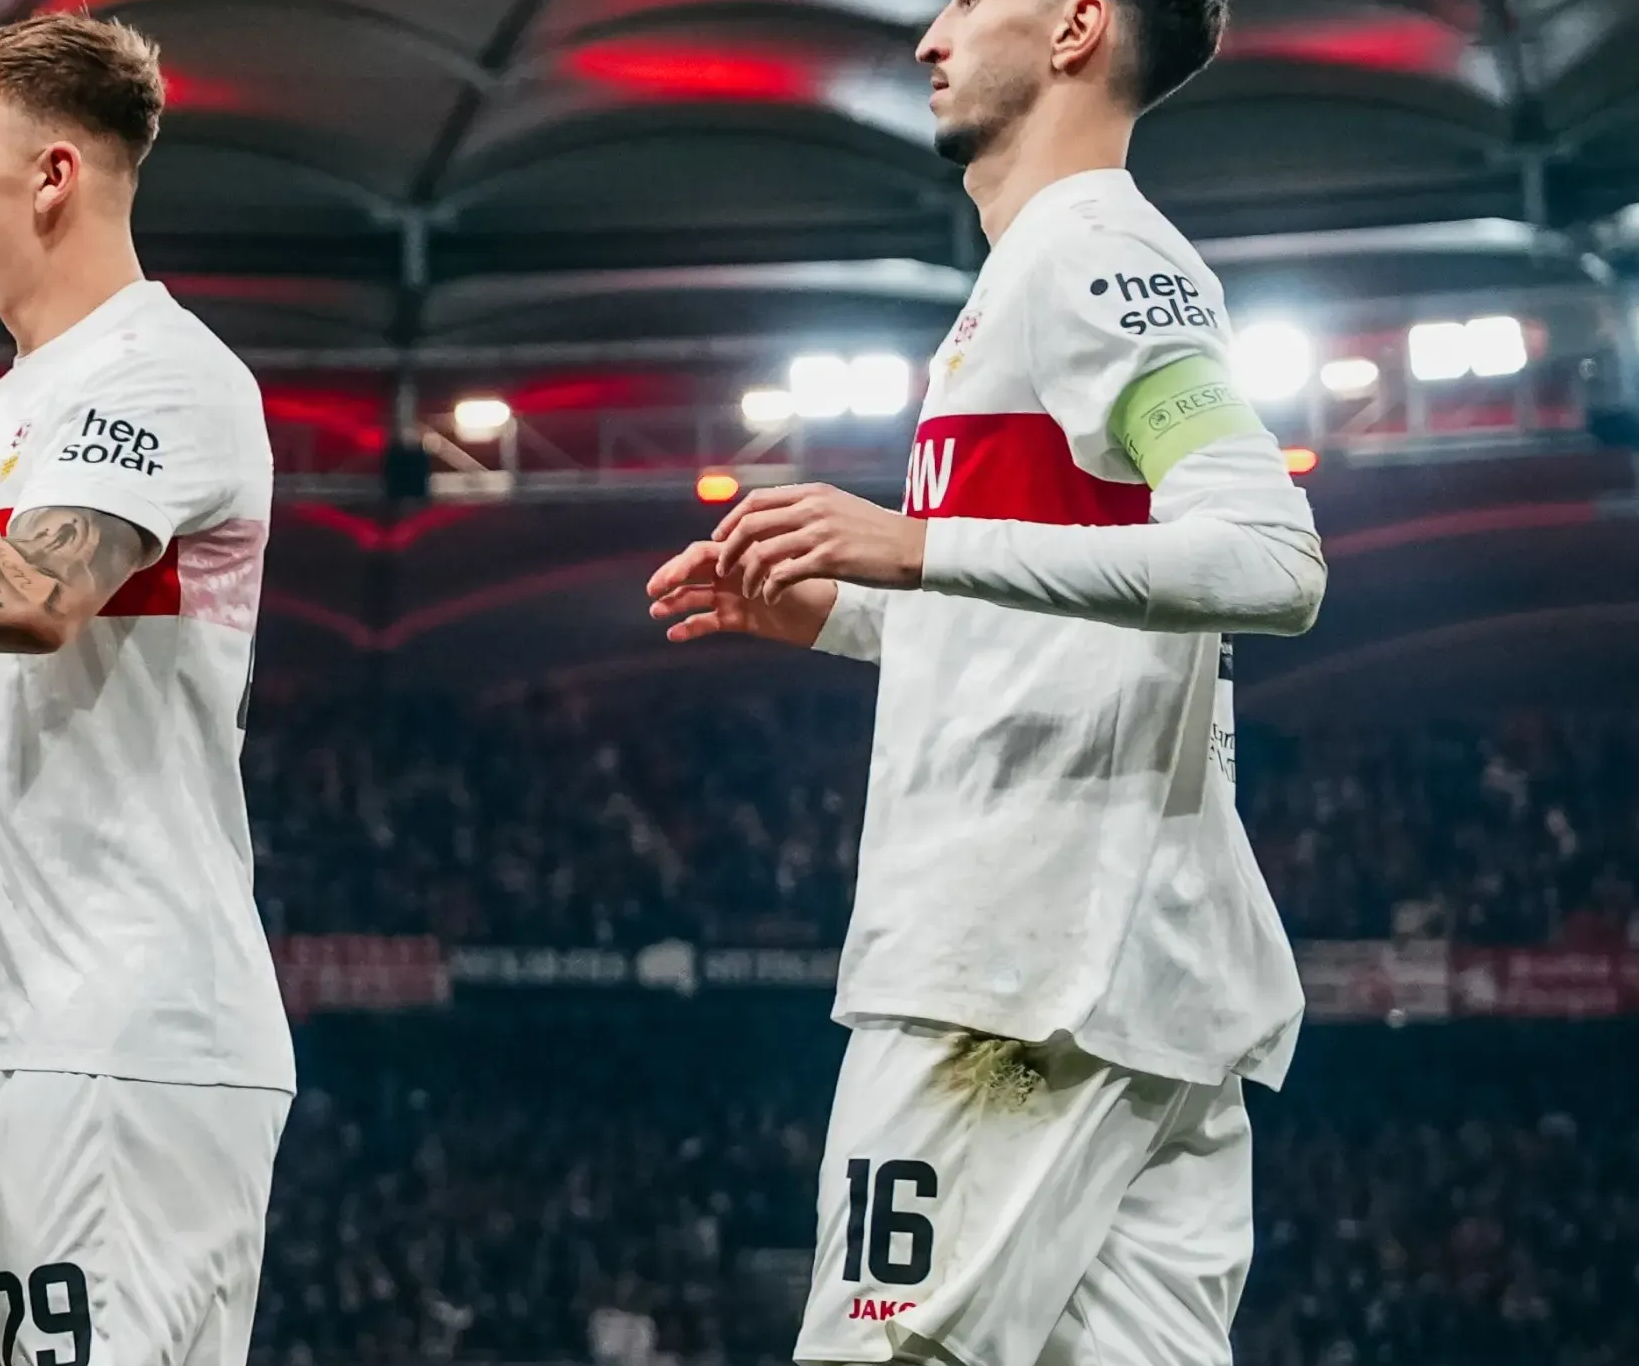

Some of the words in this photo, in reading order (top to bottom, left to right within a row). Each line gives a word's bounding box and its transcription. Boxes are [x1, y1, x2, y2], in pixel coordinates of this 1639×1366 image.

[1115, 273, 1199, 303] hep
[1120, 299, 1218, 335] solar
[1176, 388, 1238, 414] RESP
[82, 408, 159, 452] hep
[58, 444, 164, 476] solar
[842, 1158, 938, 1285] 16
